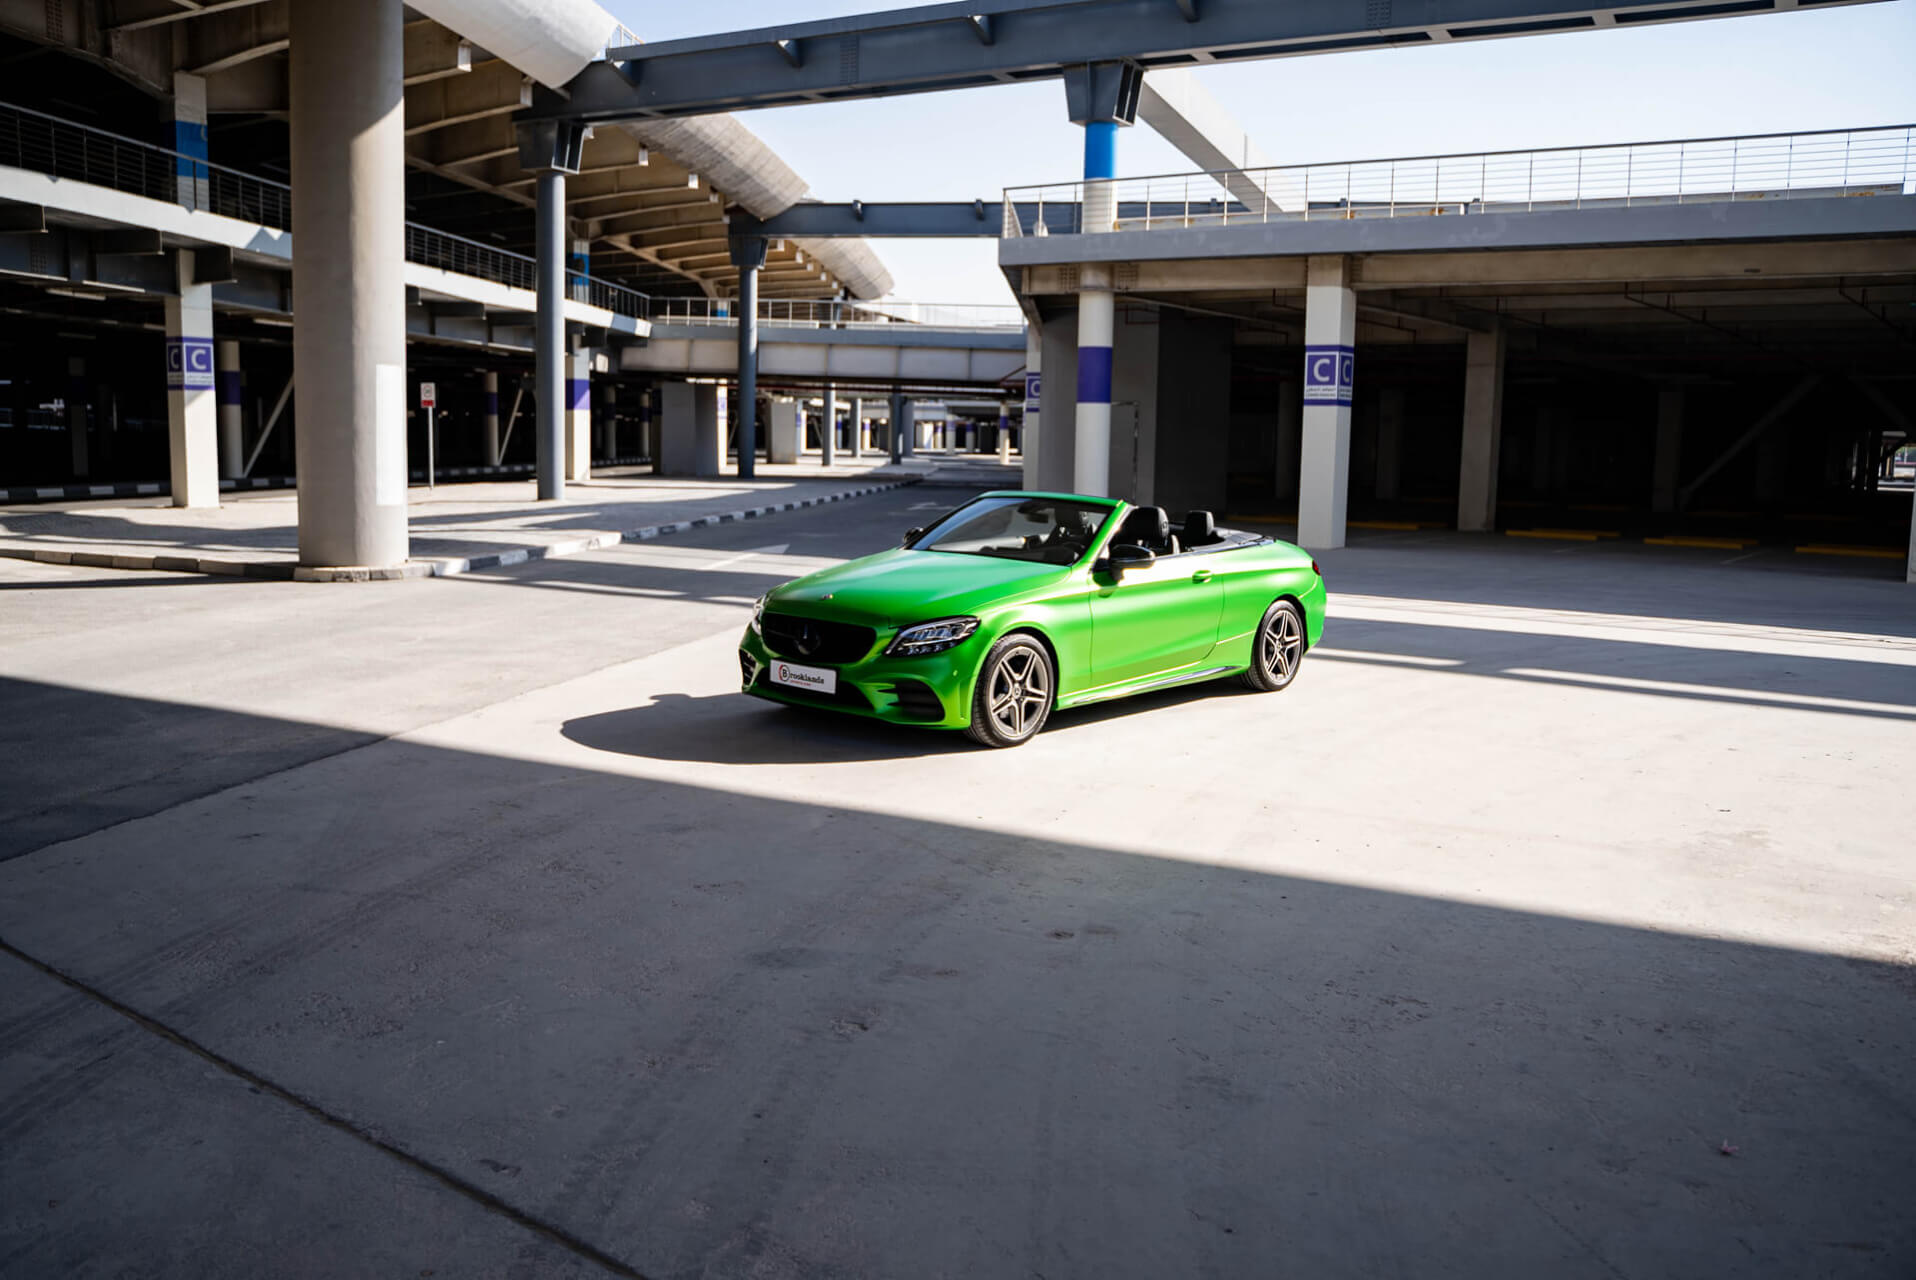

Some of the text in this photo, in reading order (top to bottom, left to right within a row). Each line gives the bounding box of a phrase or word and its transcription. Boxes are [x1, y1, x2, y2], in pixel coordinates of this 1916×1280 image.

[170, 348, 179, 369] C
[191, 349, 206, 370] C
[1313, 358, 1330, 382] C
[1343, 360, 1351, 383] C
[780, 667, 825, 684] Brooklands
